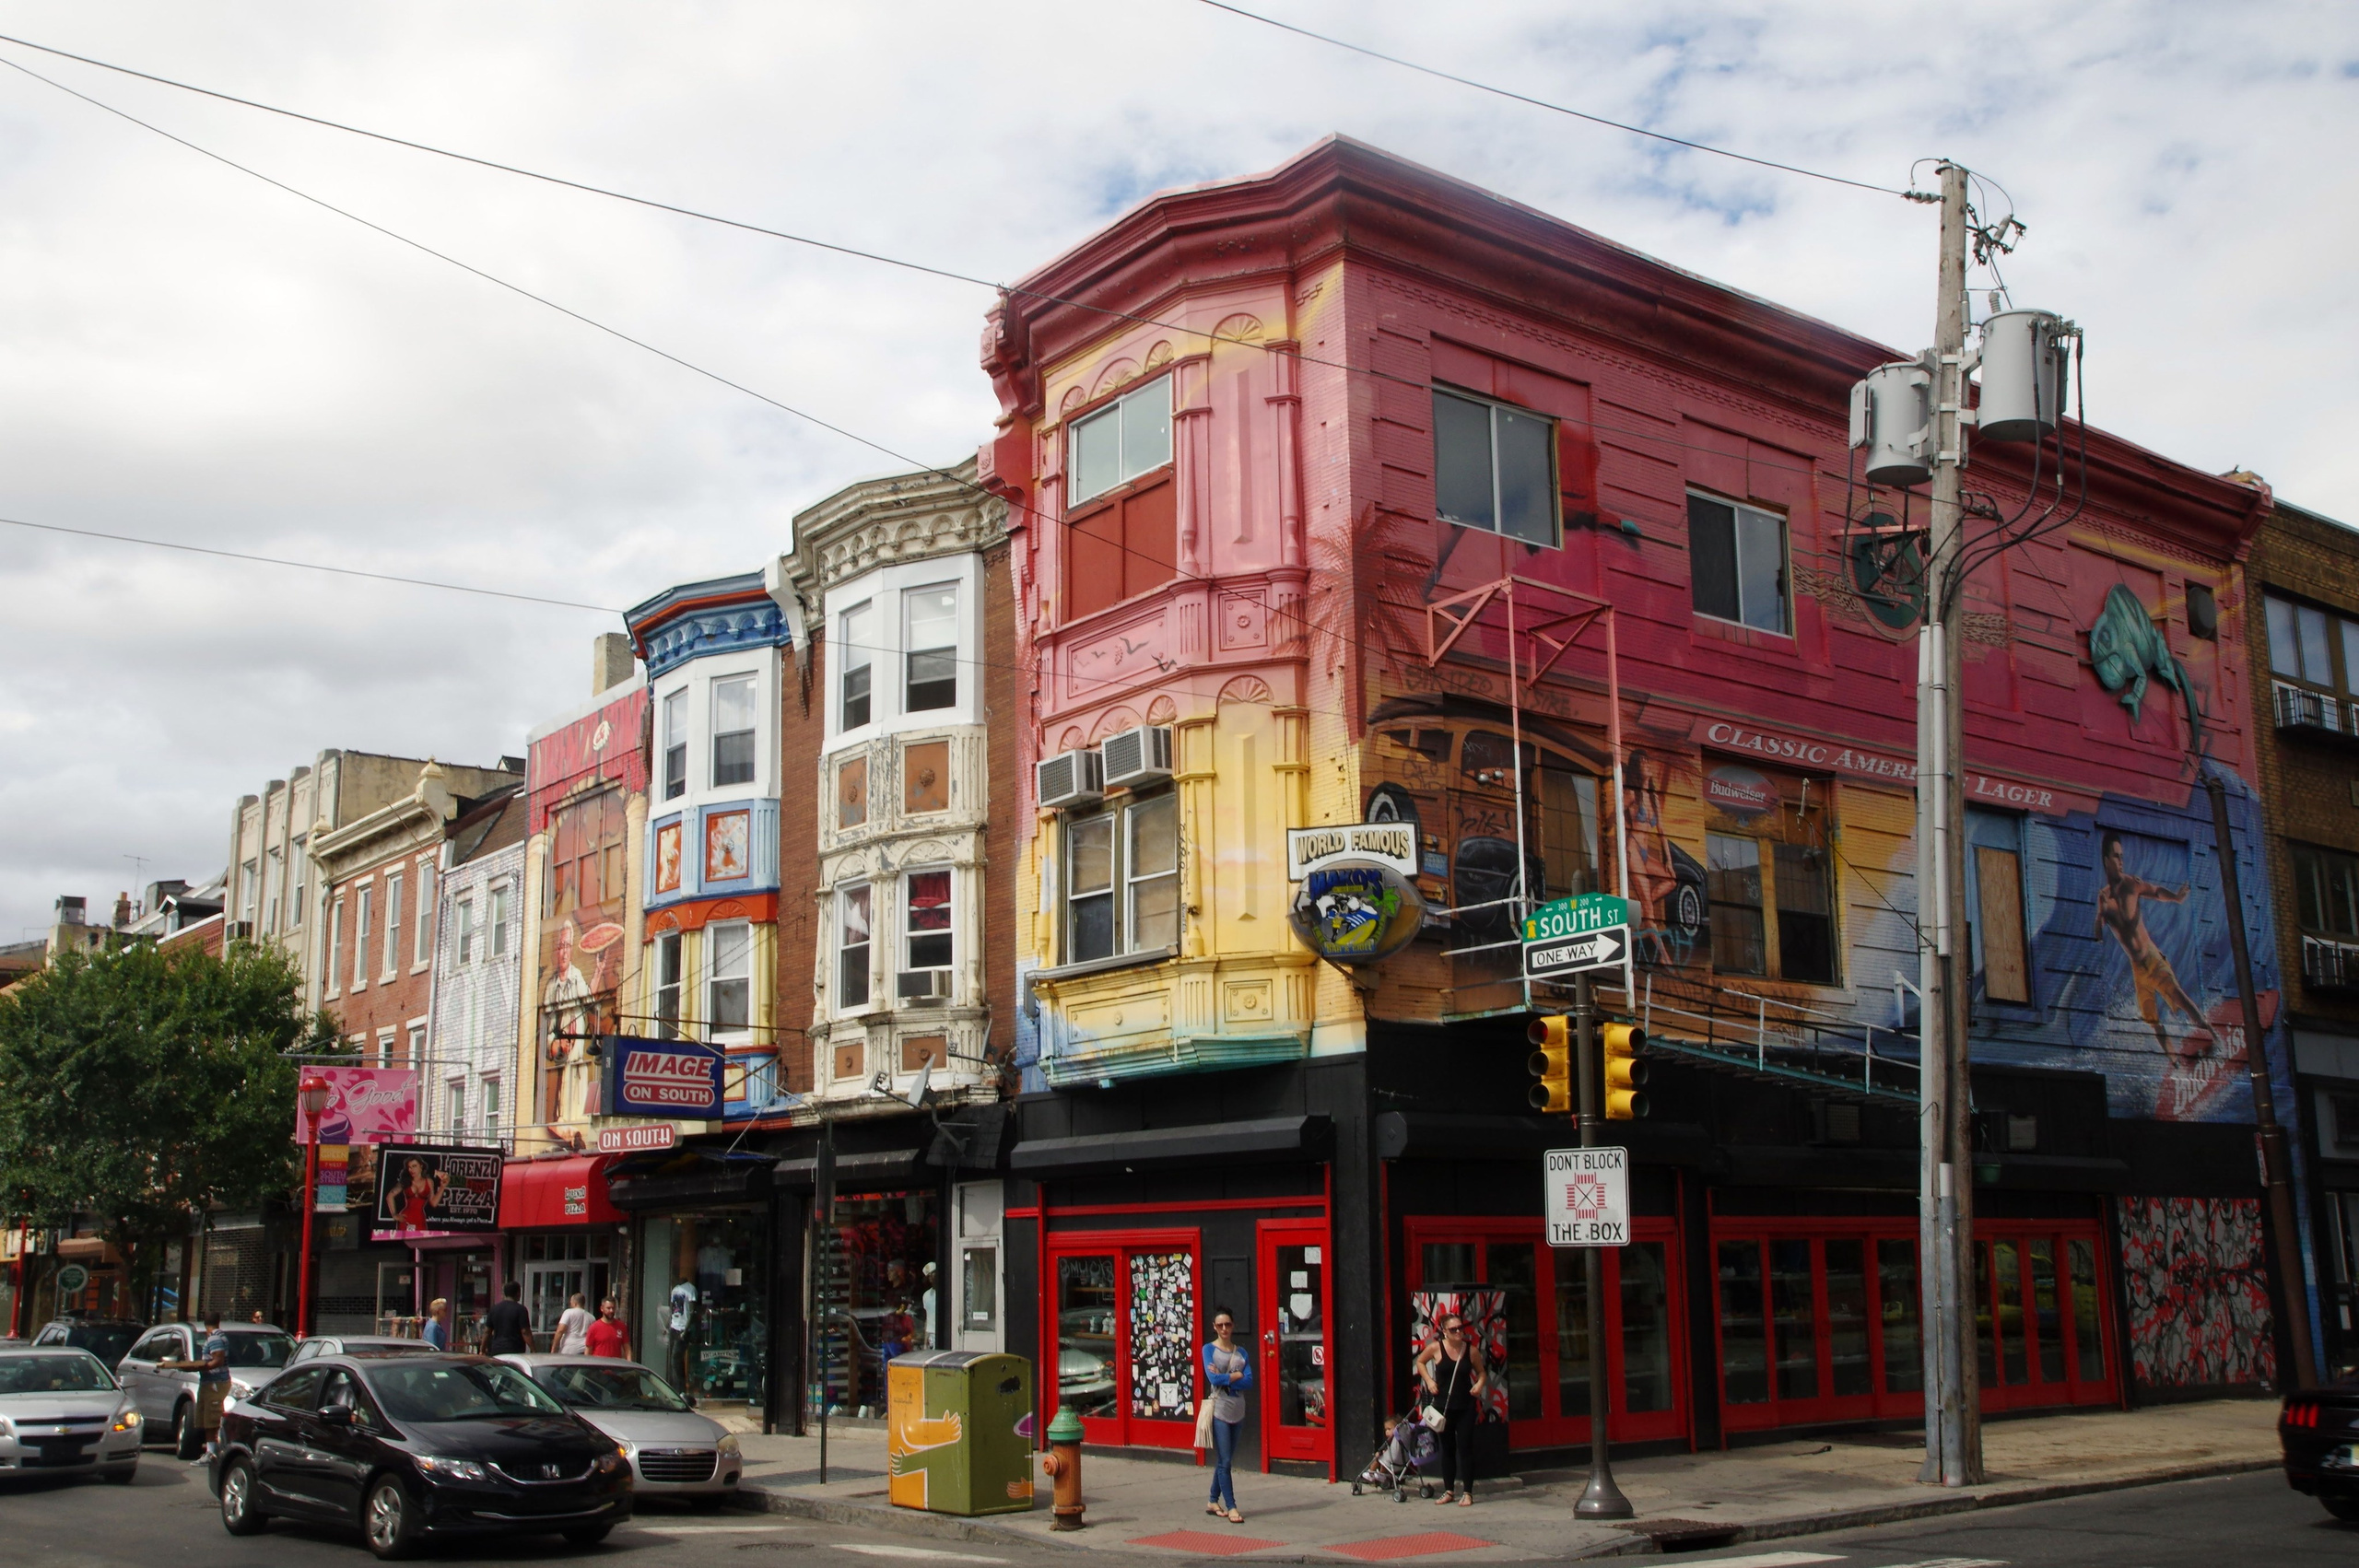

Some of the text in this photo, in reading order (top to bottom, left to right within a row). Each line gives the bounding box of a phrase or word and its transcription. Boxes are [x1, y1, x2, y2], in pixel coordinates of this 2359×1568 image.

[1708, 723, 1827, 764] CLASSIC
[1975, 776, 2052, 808] LAGER
[1709, 780, 1766, 803] Budweiser
[1295, 830, 1411, 865] WORLD FAMOUS
[1557, 897, 1590, 911] 300 W 200
[1540, 906, 1619, 938] SOUTH ST
[1536, 942, 1596, 965] ONE WAY
[626, 1052, 714, 1077] IMAGE
[346, 1071, 416, 1115] Good
[629, 1086, 710, 1103] ON SOUTH
[602, 1128, 671, 1149] ON SOUTH
[439, 1152, 501, 1179] LORENZO
[1584, 1153, 1623, 1170] BLOCK
[439, 1187, 497, 1209] PIZZA
[565, 1202, 586, 1215] PIZZA
[463, 1207, 478, 1215] 1970
[1553, 1223, 1623, 1241] THE BOX
